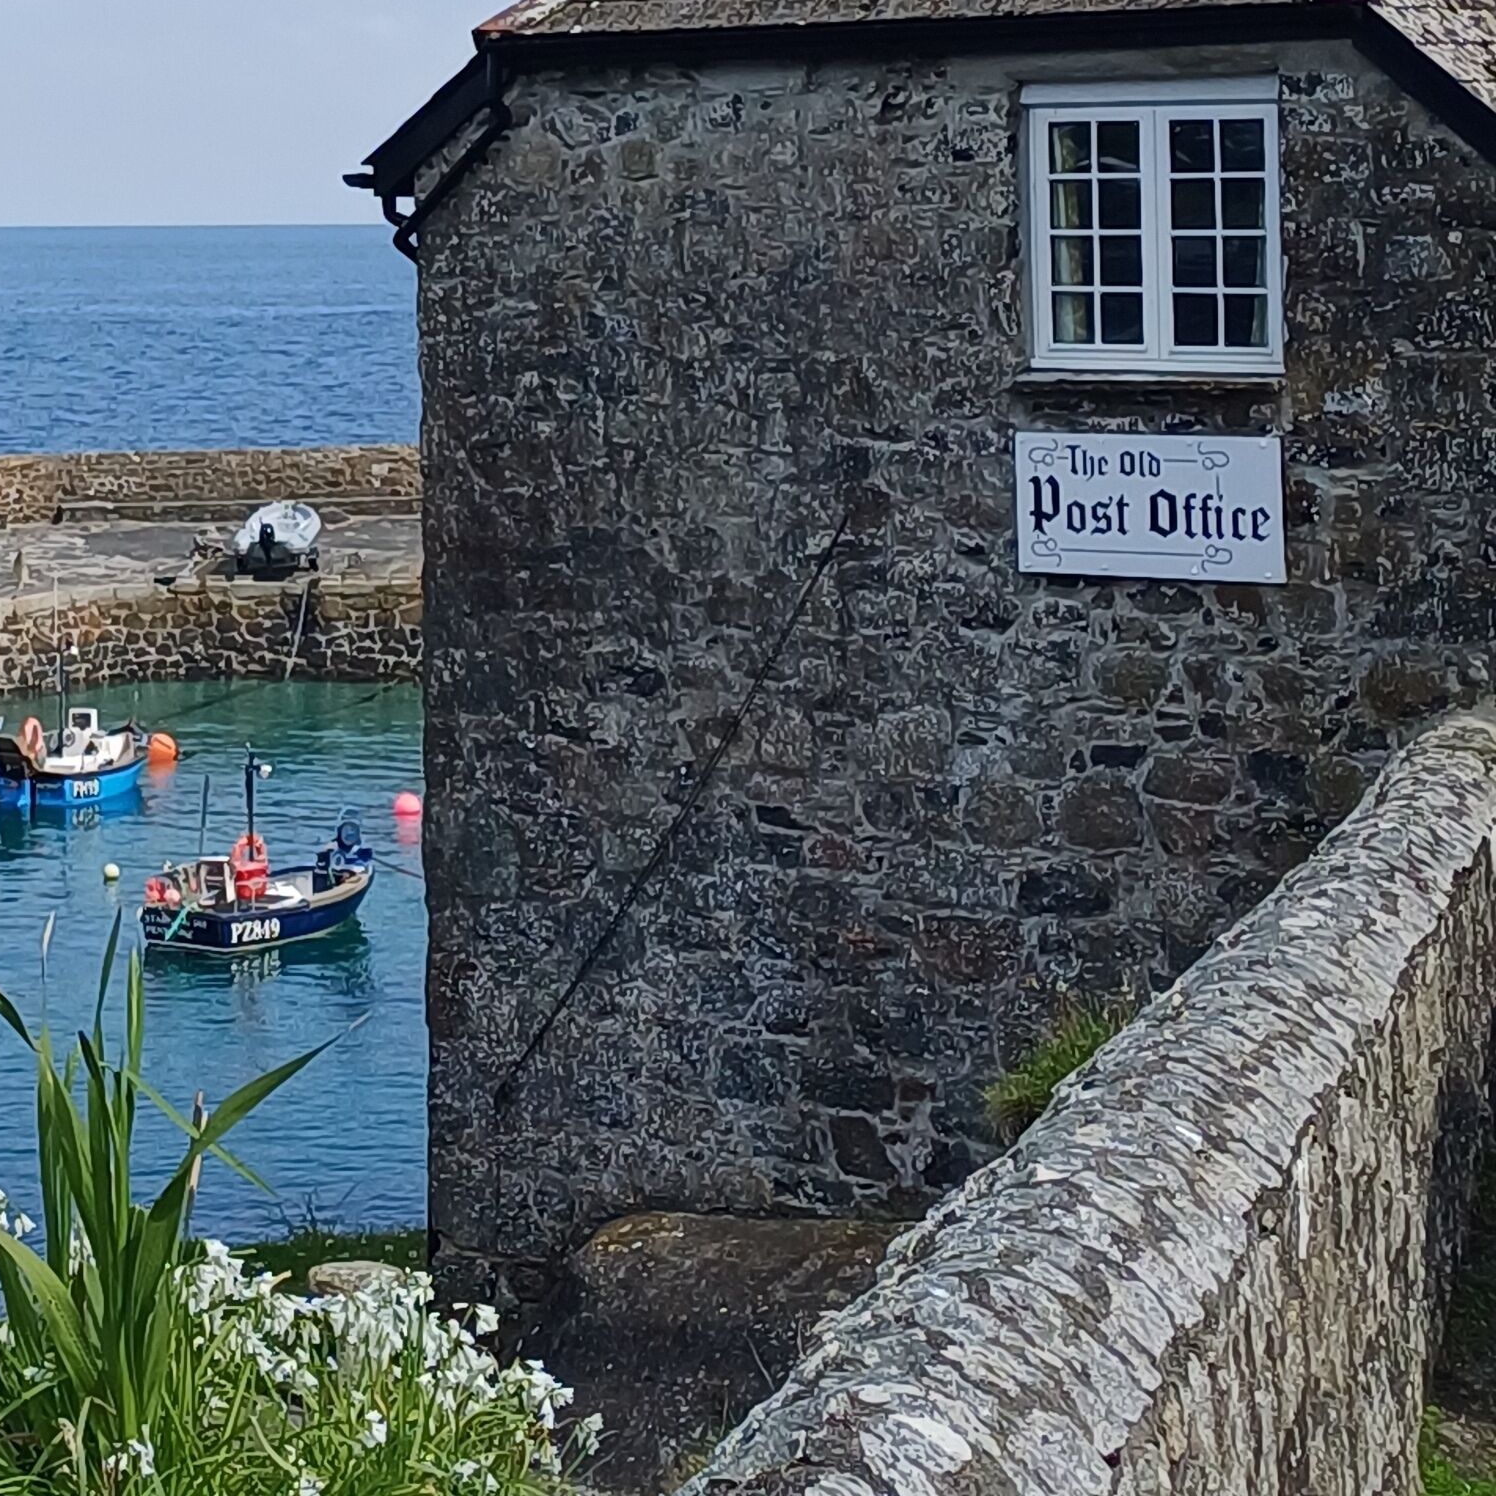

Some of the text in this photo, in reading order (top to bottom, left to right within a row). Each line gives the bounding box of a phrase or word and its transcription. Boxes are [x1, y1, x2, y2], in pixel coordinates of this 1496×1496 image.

[1064, 444, 1161, 481] The Old
[1028, 474, 1271, 542] Post Office
